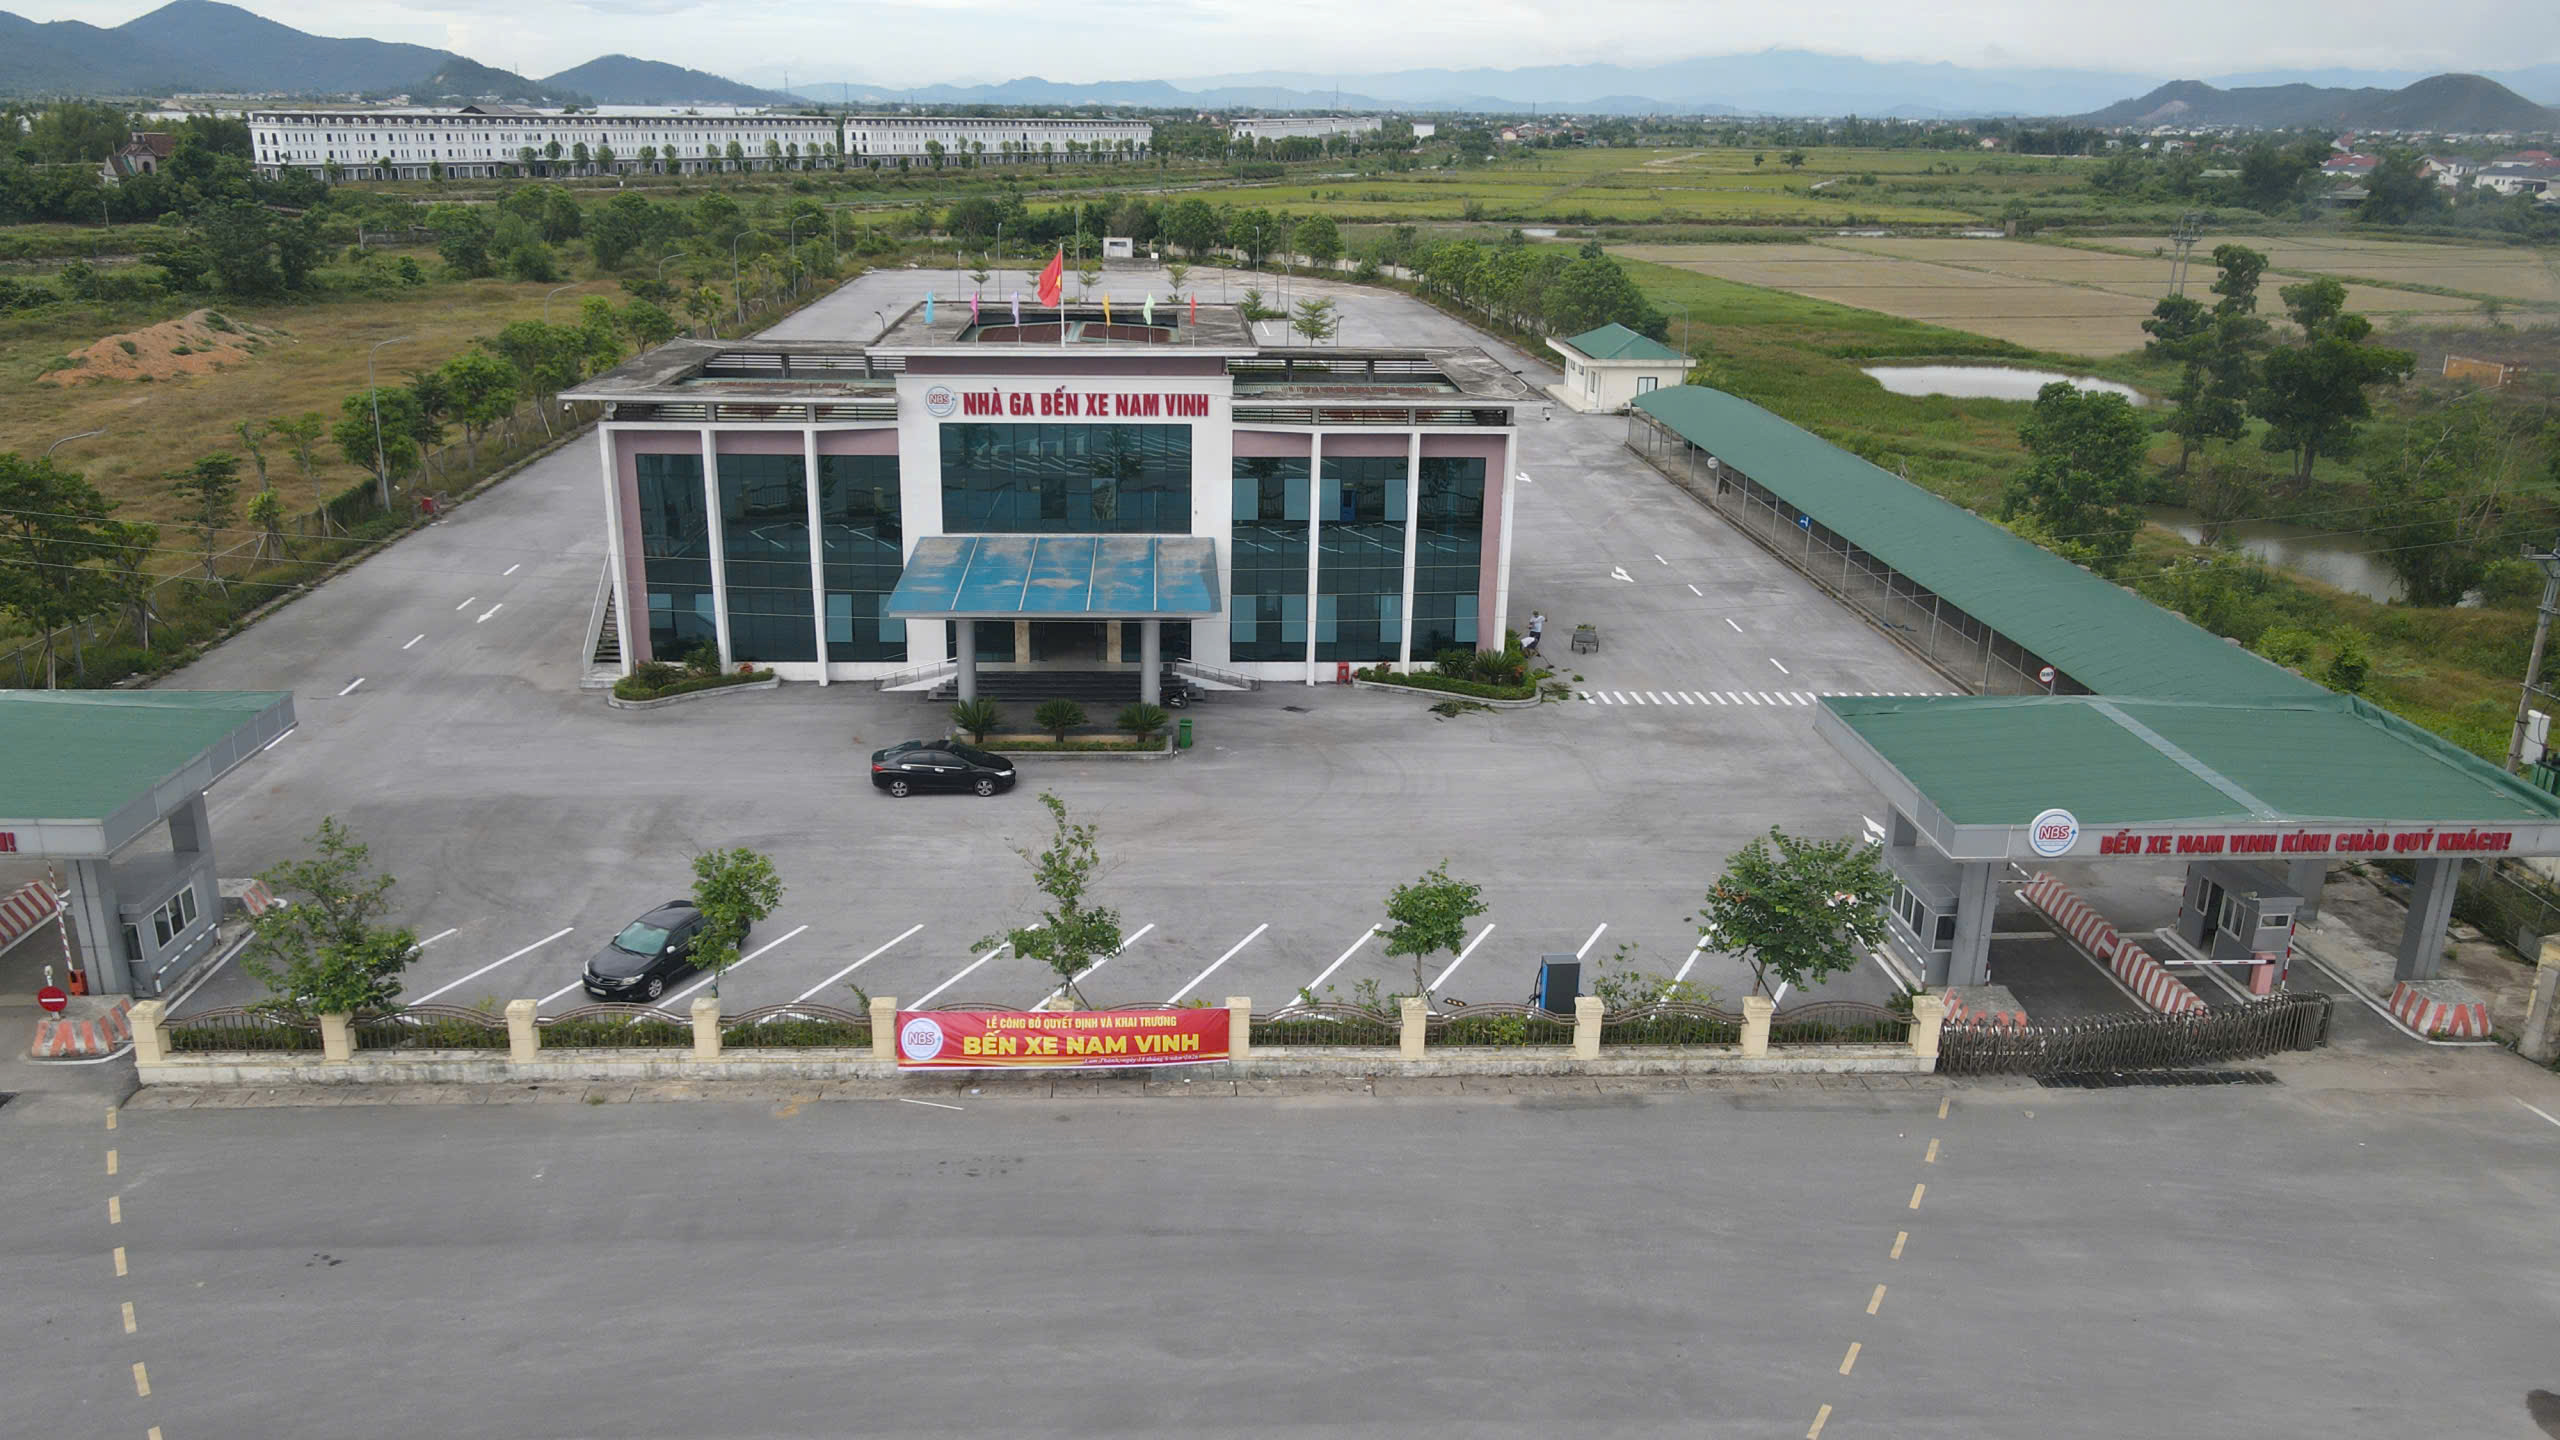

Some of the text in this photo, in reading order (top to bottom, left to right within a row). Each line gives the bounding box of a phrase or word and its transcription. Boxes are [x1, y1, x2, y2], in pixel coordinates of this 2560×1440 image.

[928, 394, 951, 405] NBS
[963, 385, 1209, 417] NHÀ GA BẾN XE NAM VINH
[2039, 825, 2070, 840] NBS
[2100, 828, 2513, 855] BẾN XE NAM VINH KÍNH CHÀO QUÝ KHÁCH!
[1000, 1015, 1026, 1029] CÔNG
[1075, 1017, 1098, 1031] ĐỊNH
[1100, 1016, 1113, 1029] VÀ
[1115, 1016, 1137, 1028] KHAI
[907, 1031, 936, 1046] NBS
[963, 1029, 1200, 1056] BẾN XE NAM VINH
